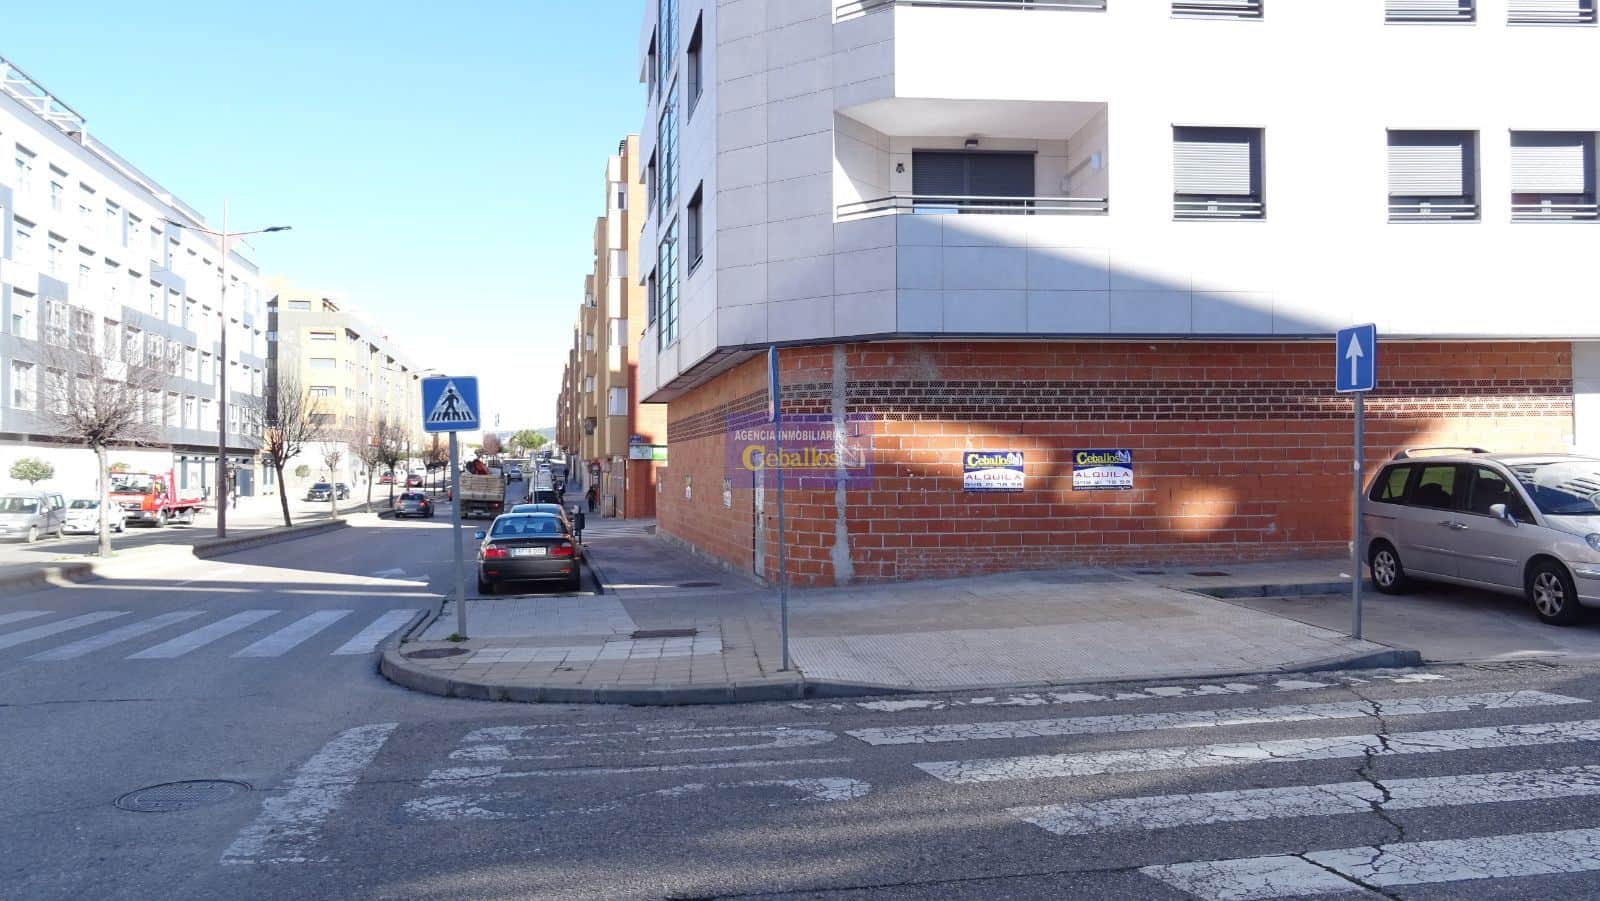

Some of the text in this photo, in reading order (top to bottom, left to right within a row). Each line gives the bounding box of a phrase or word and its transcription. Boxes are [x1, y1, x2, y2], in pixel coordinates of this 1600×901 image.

[967, 453, 1012, 467] Ceballos
[1076, 451, 1121, 465] Ceballos
[966, 473, 1022, 481] ALQUILA
